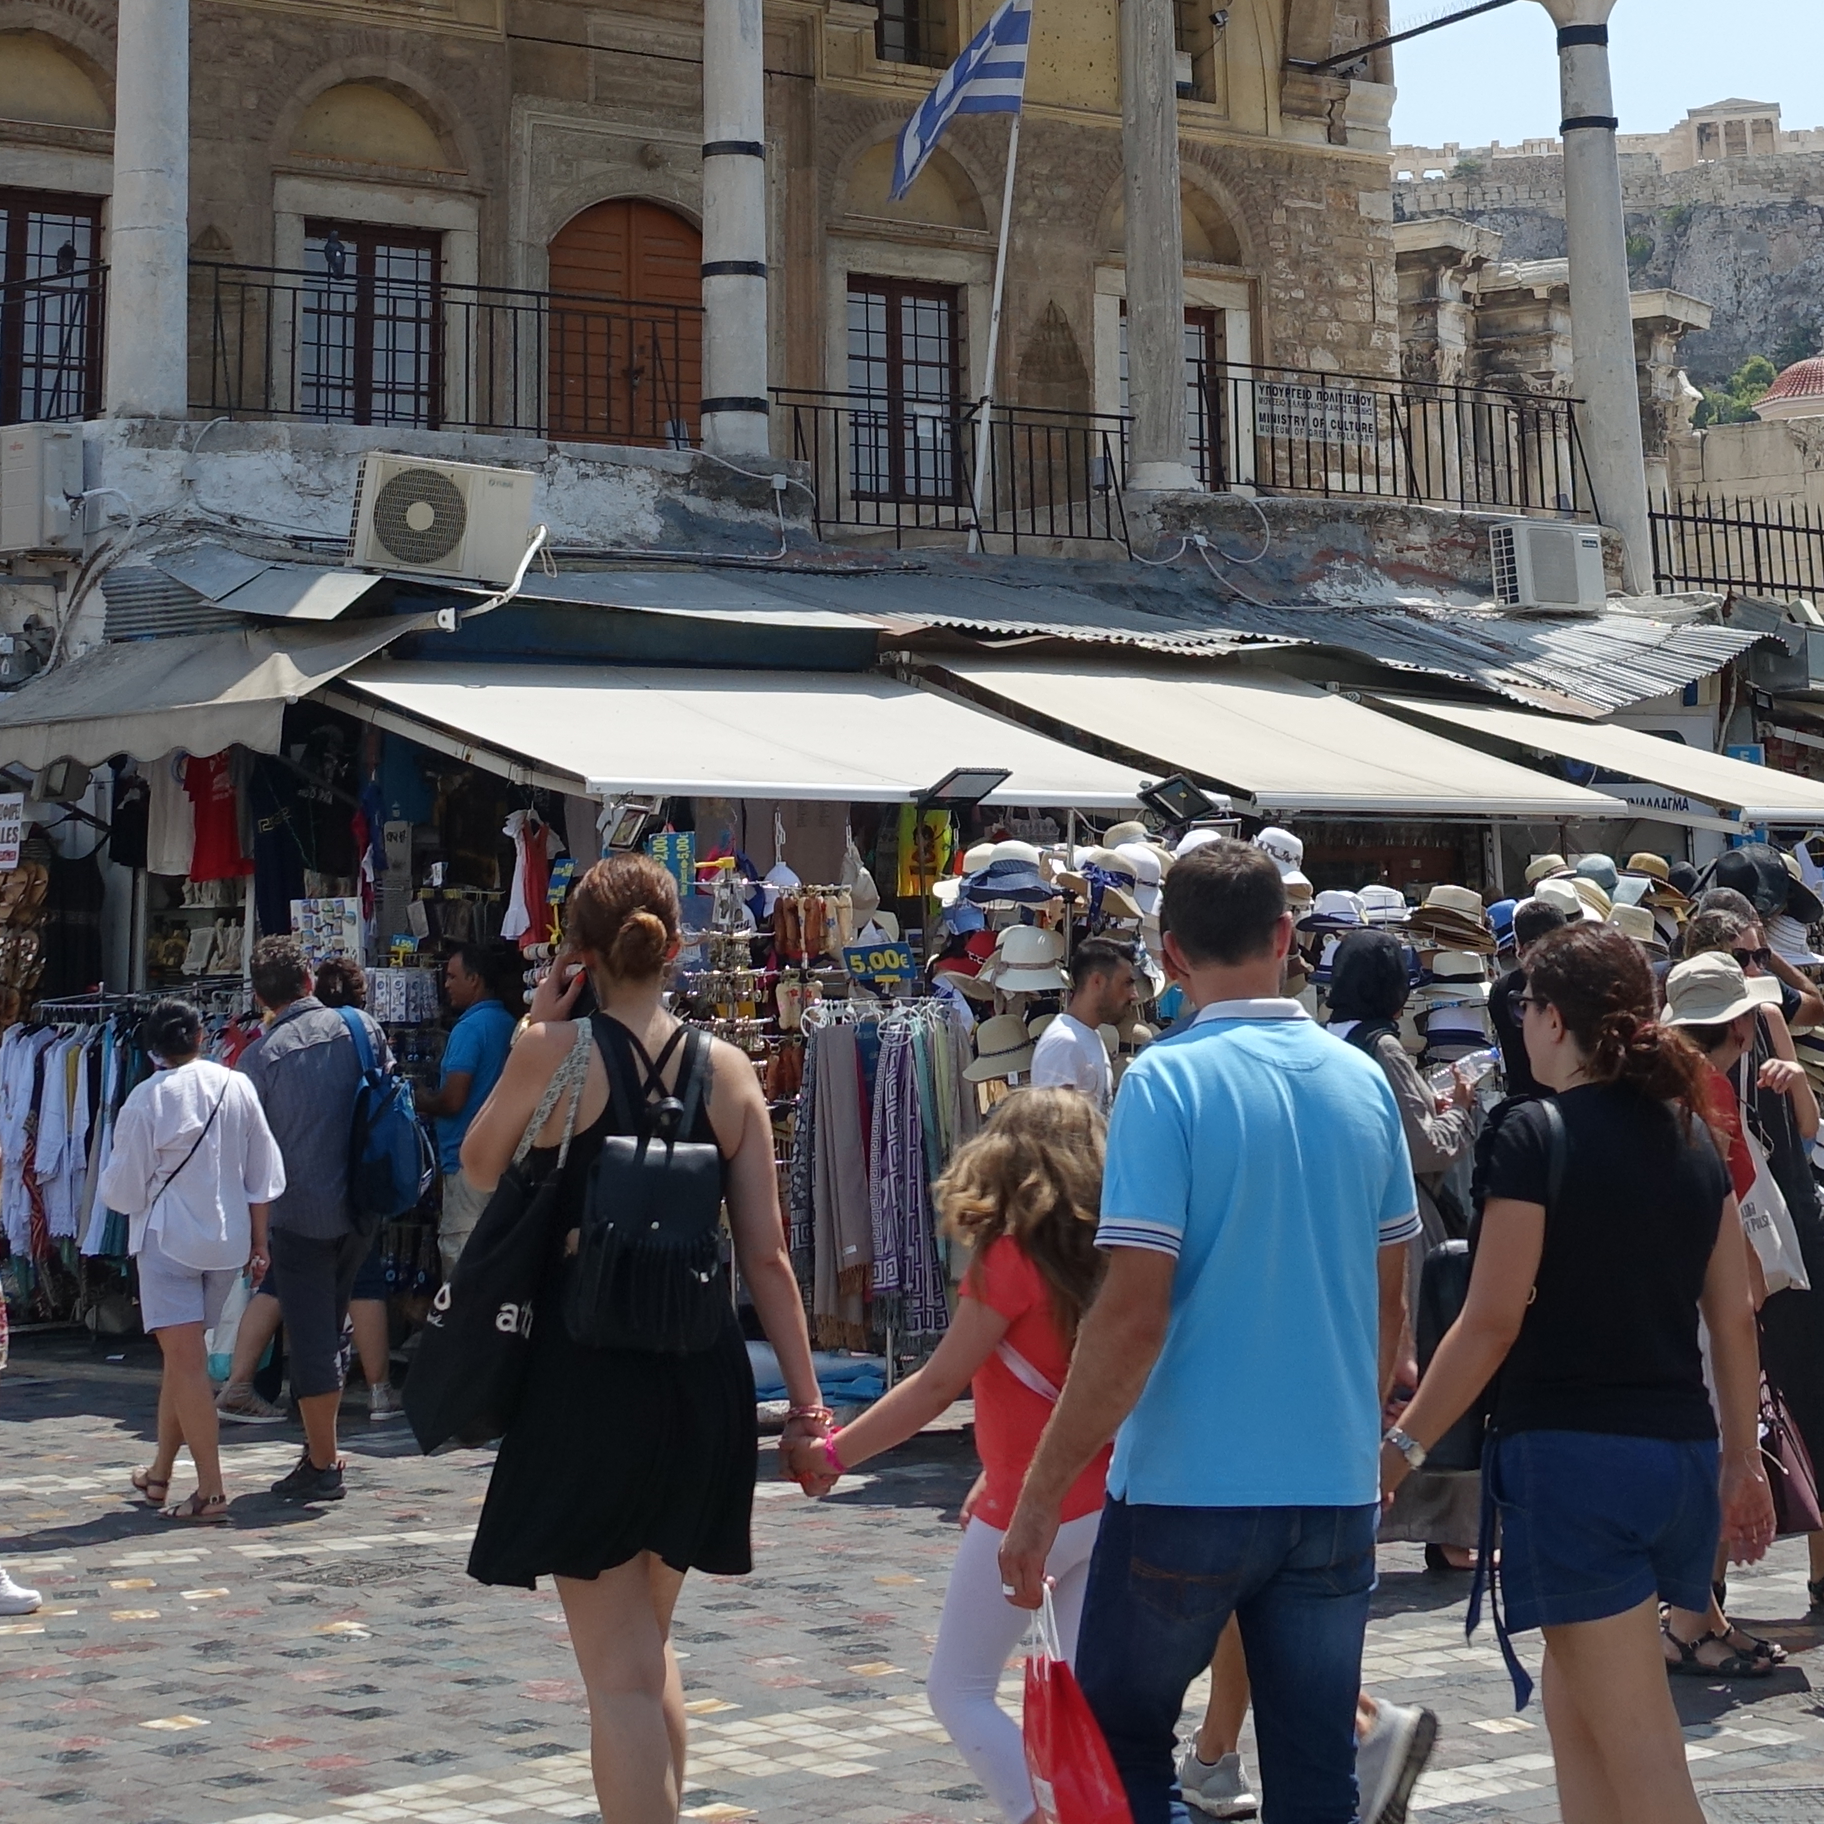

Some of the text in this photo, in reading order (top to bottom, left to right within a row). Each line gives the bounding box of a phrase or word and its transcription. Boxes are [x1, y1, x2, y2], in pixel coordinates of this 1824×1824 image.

[1259, 385, 1372, 405] ΥΠΟΥΡΓΕΙΟ ΠΟΛΙΤΙΣΜΟΥ
[1259, 412, 1374, 434] MINISTRY OF CULTURE
[1294, 427, 1304, 436] OF
[850, 949, 910, 974] 5,00€
